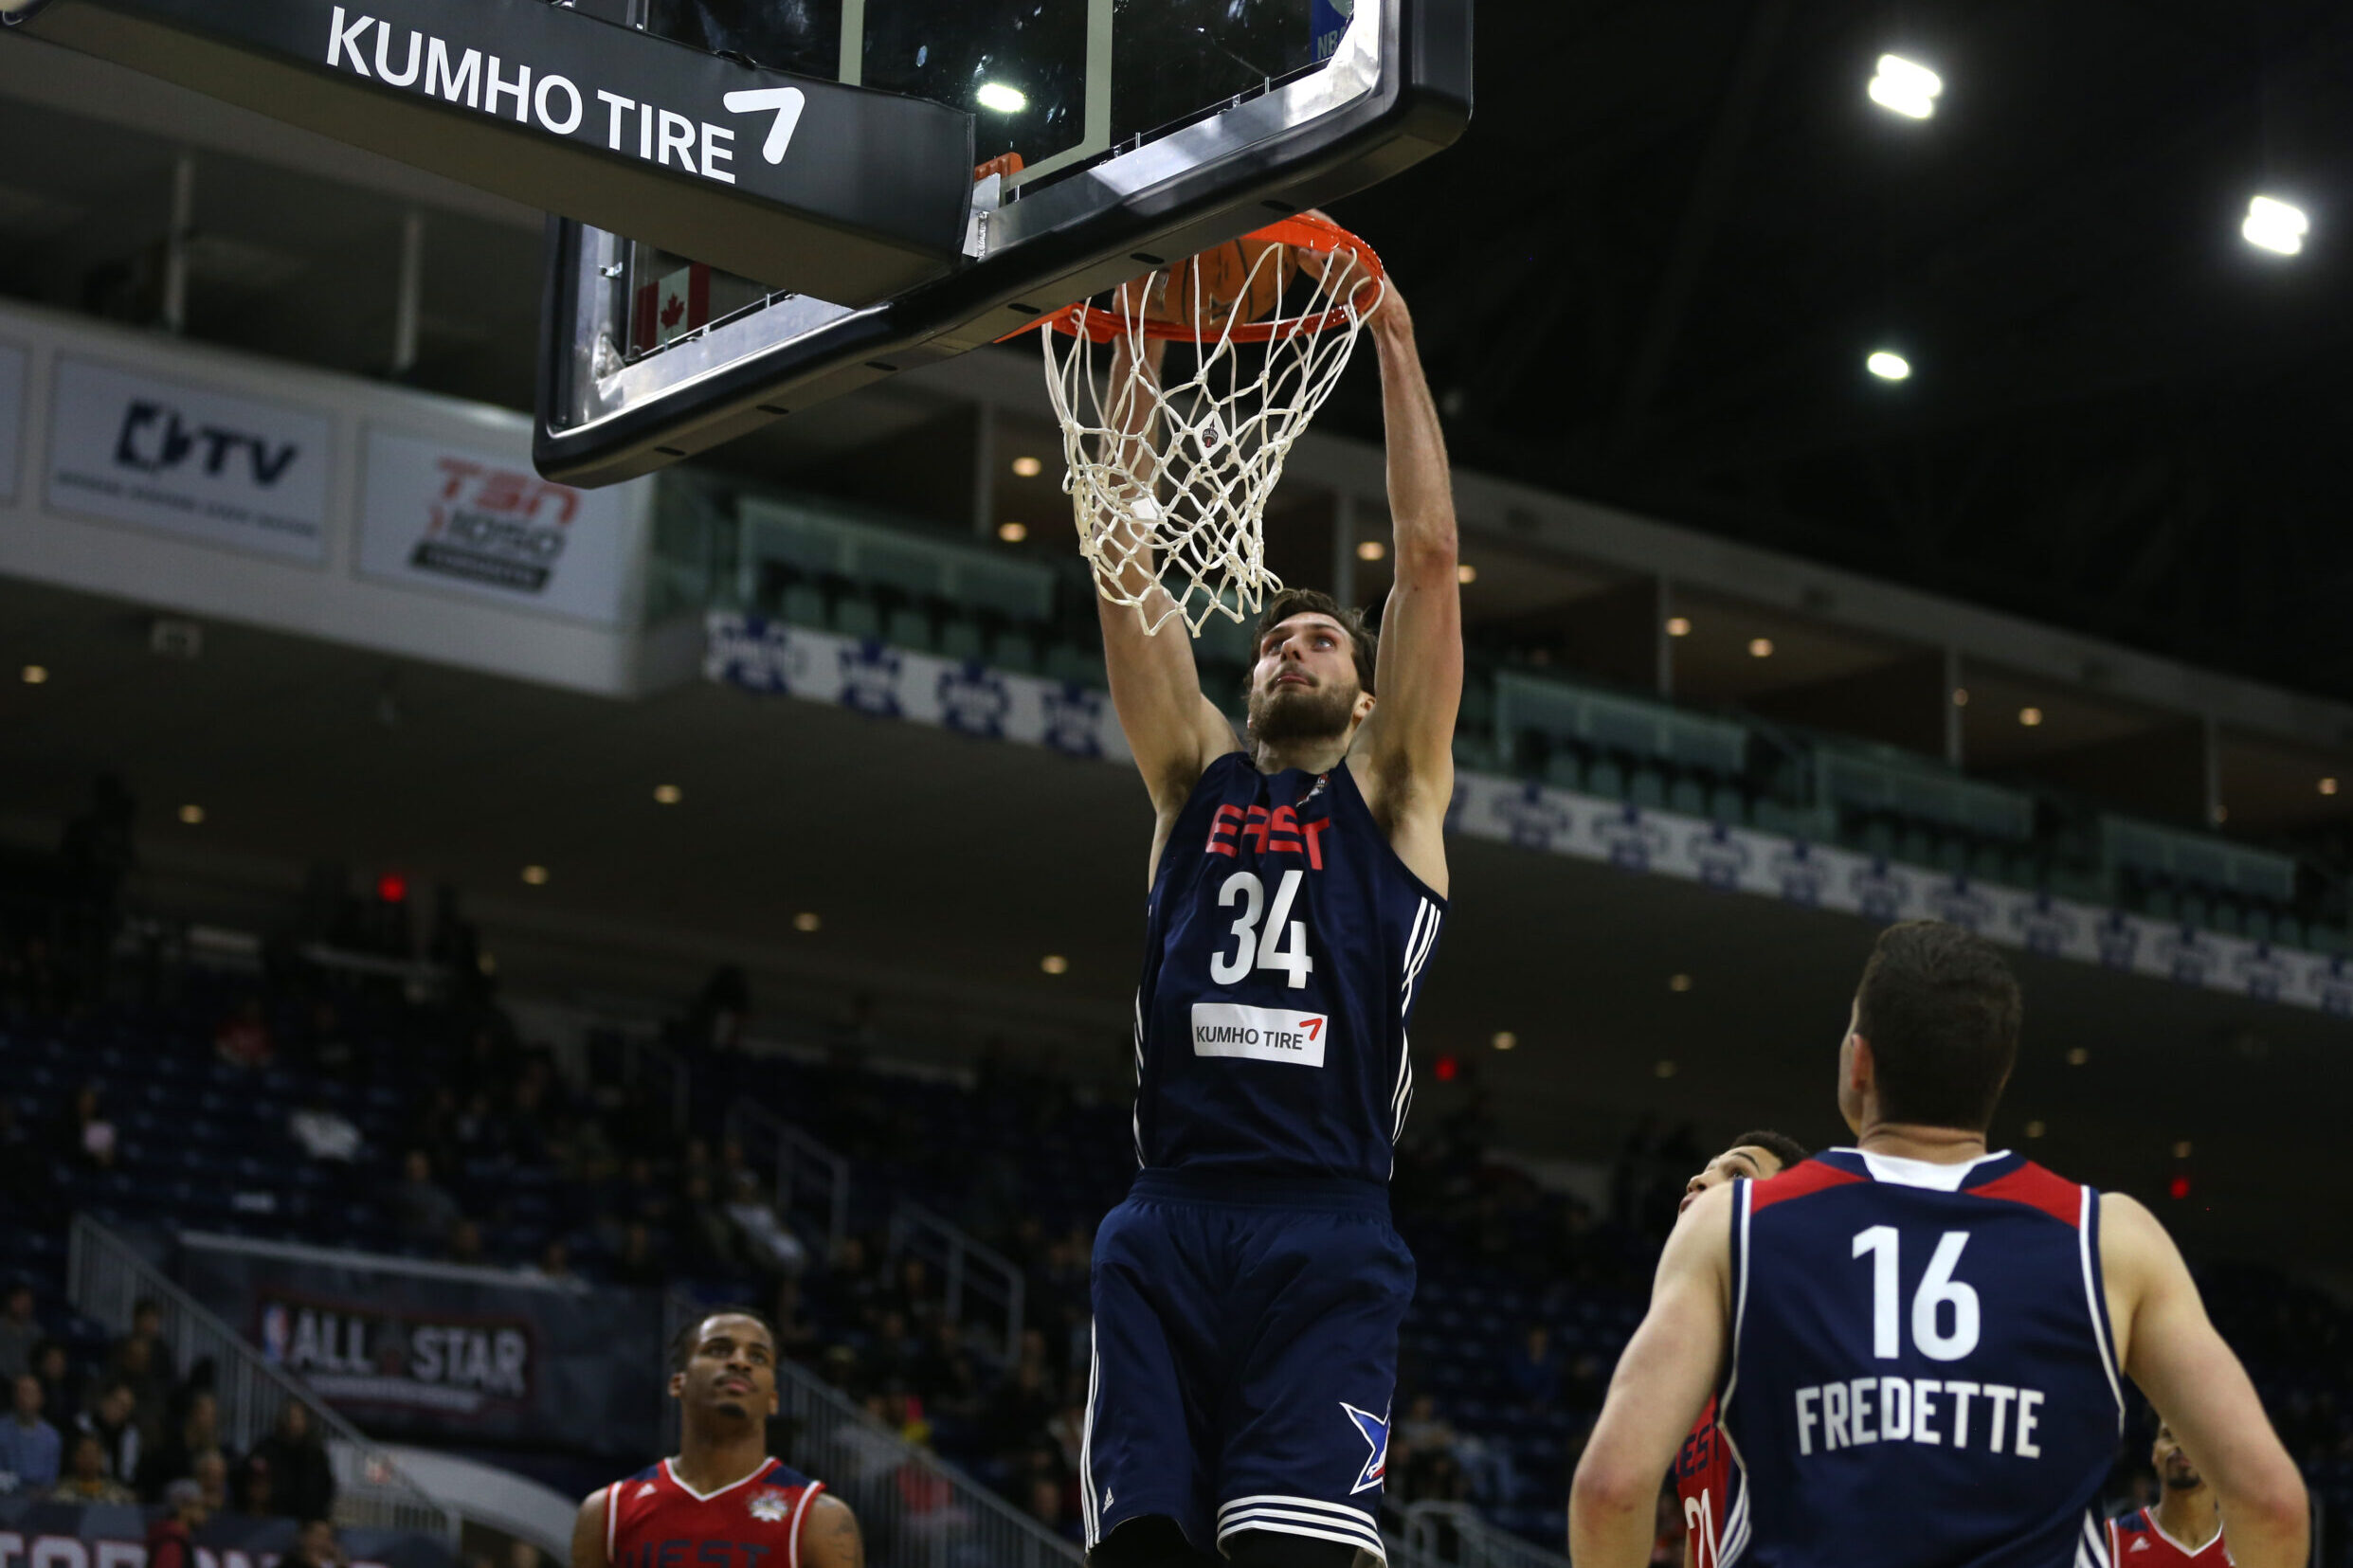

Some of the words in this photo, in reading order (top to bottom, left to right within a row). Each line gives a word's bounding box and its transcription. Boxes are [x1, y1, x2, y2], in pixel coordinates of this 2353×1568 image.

[327, 6, 583, 135] KUMHO
[597, 89, 735, 184] TIRE
[1205, 804, 1330, 871] EAST
[1210, 870, 1312, 989] 34
[1196, 1026, 1259, 1045] KUMHO
[1263, 1031, 1304, 1050] TIRE
[1852, 1224, 1981, 1361] 16
[288, 1306, 377, 1375] ALL
[409, 1324, 527, 1399] STAR
[1675, 1412, 1720, 1481] EST
[1796, 1376, 2045, 1459] FREDETTE
